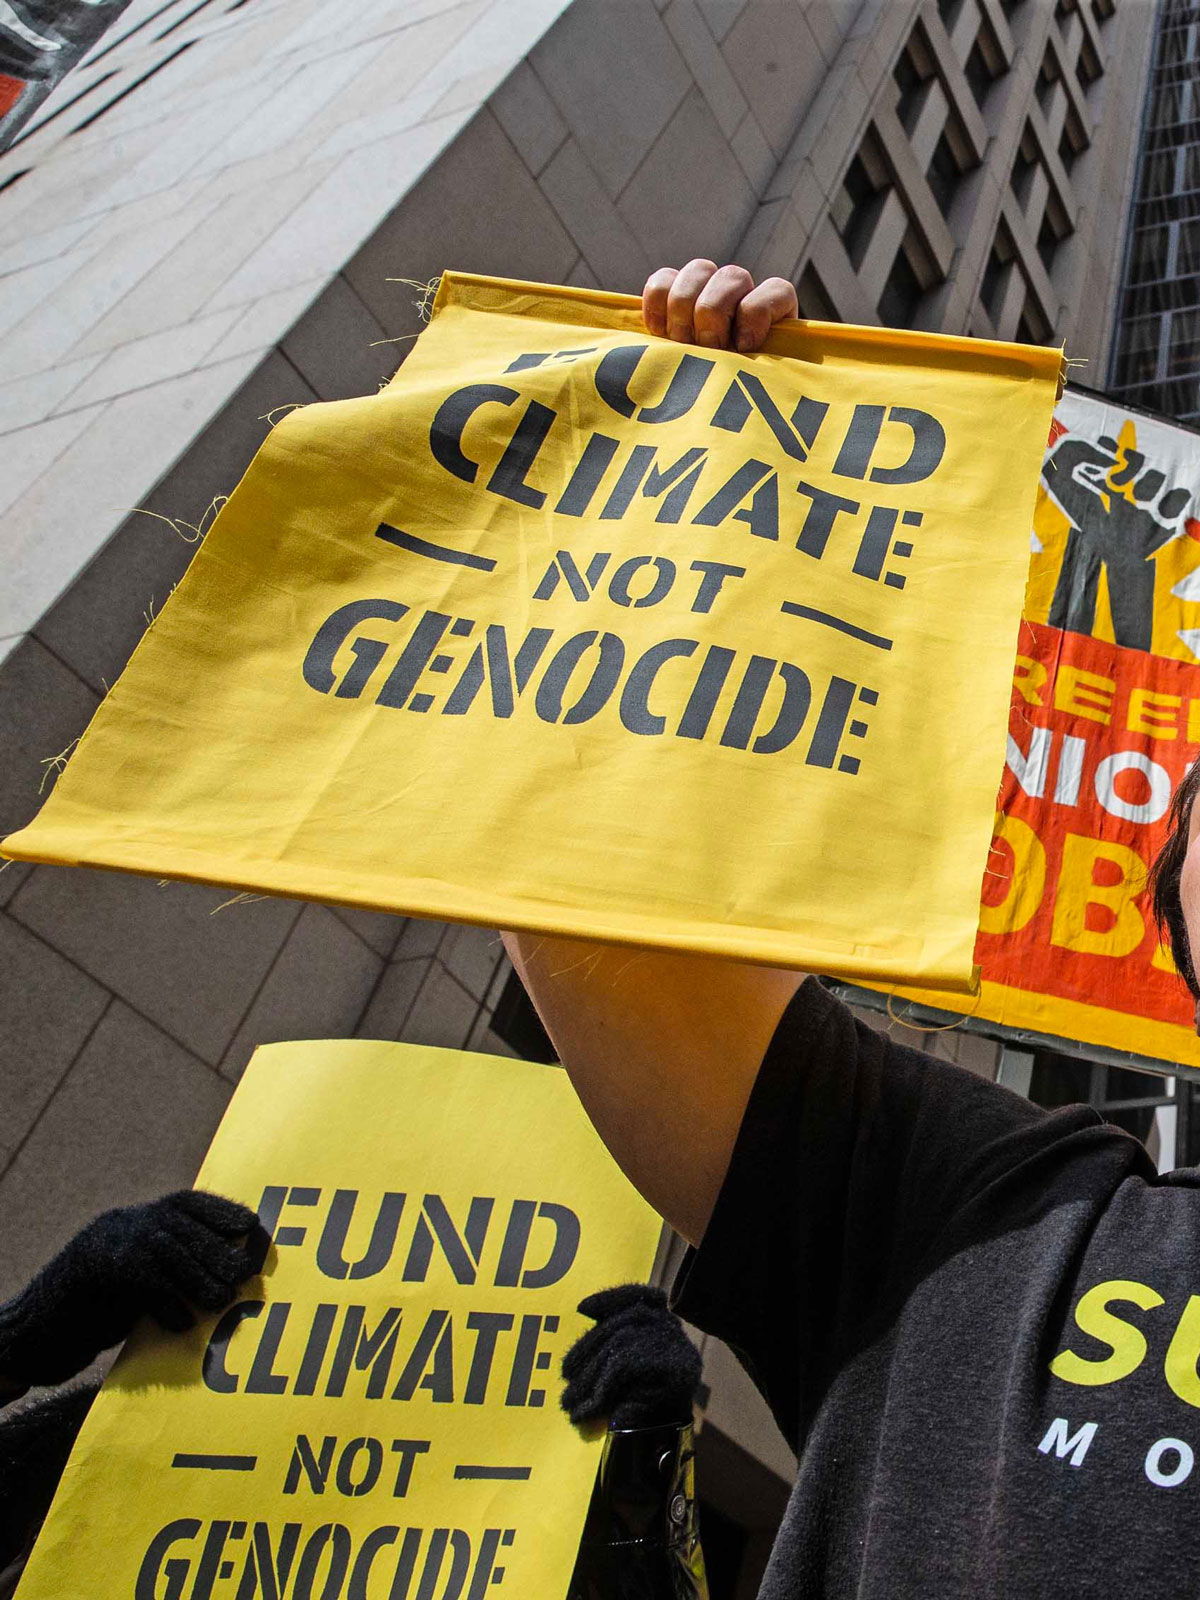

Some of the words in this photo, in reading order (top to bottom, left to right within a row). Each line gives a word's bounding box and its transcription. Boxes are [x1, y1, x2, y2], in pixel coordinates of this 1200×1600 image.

[429, 383, 923, 590] CLIMATE
[533, 550, 747, 615] NOT
[302, 598, 880, 775] GENOCIDE
[1006, 727, 1194, 825] NIO
[978, 811, 1178, 976] OB
[256, 1185, 581, 1290] FUND
[201, 1300, 560, 1408] CLIMATE
[284, 1435, 431, 1497] NOT
[134, 1517, 517, 1600] GENOCIDE
